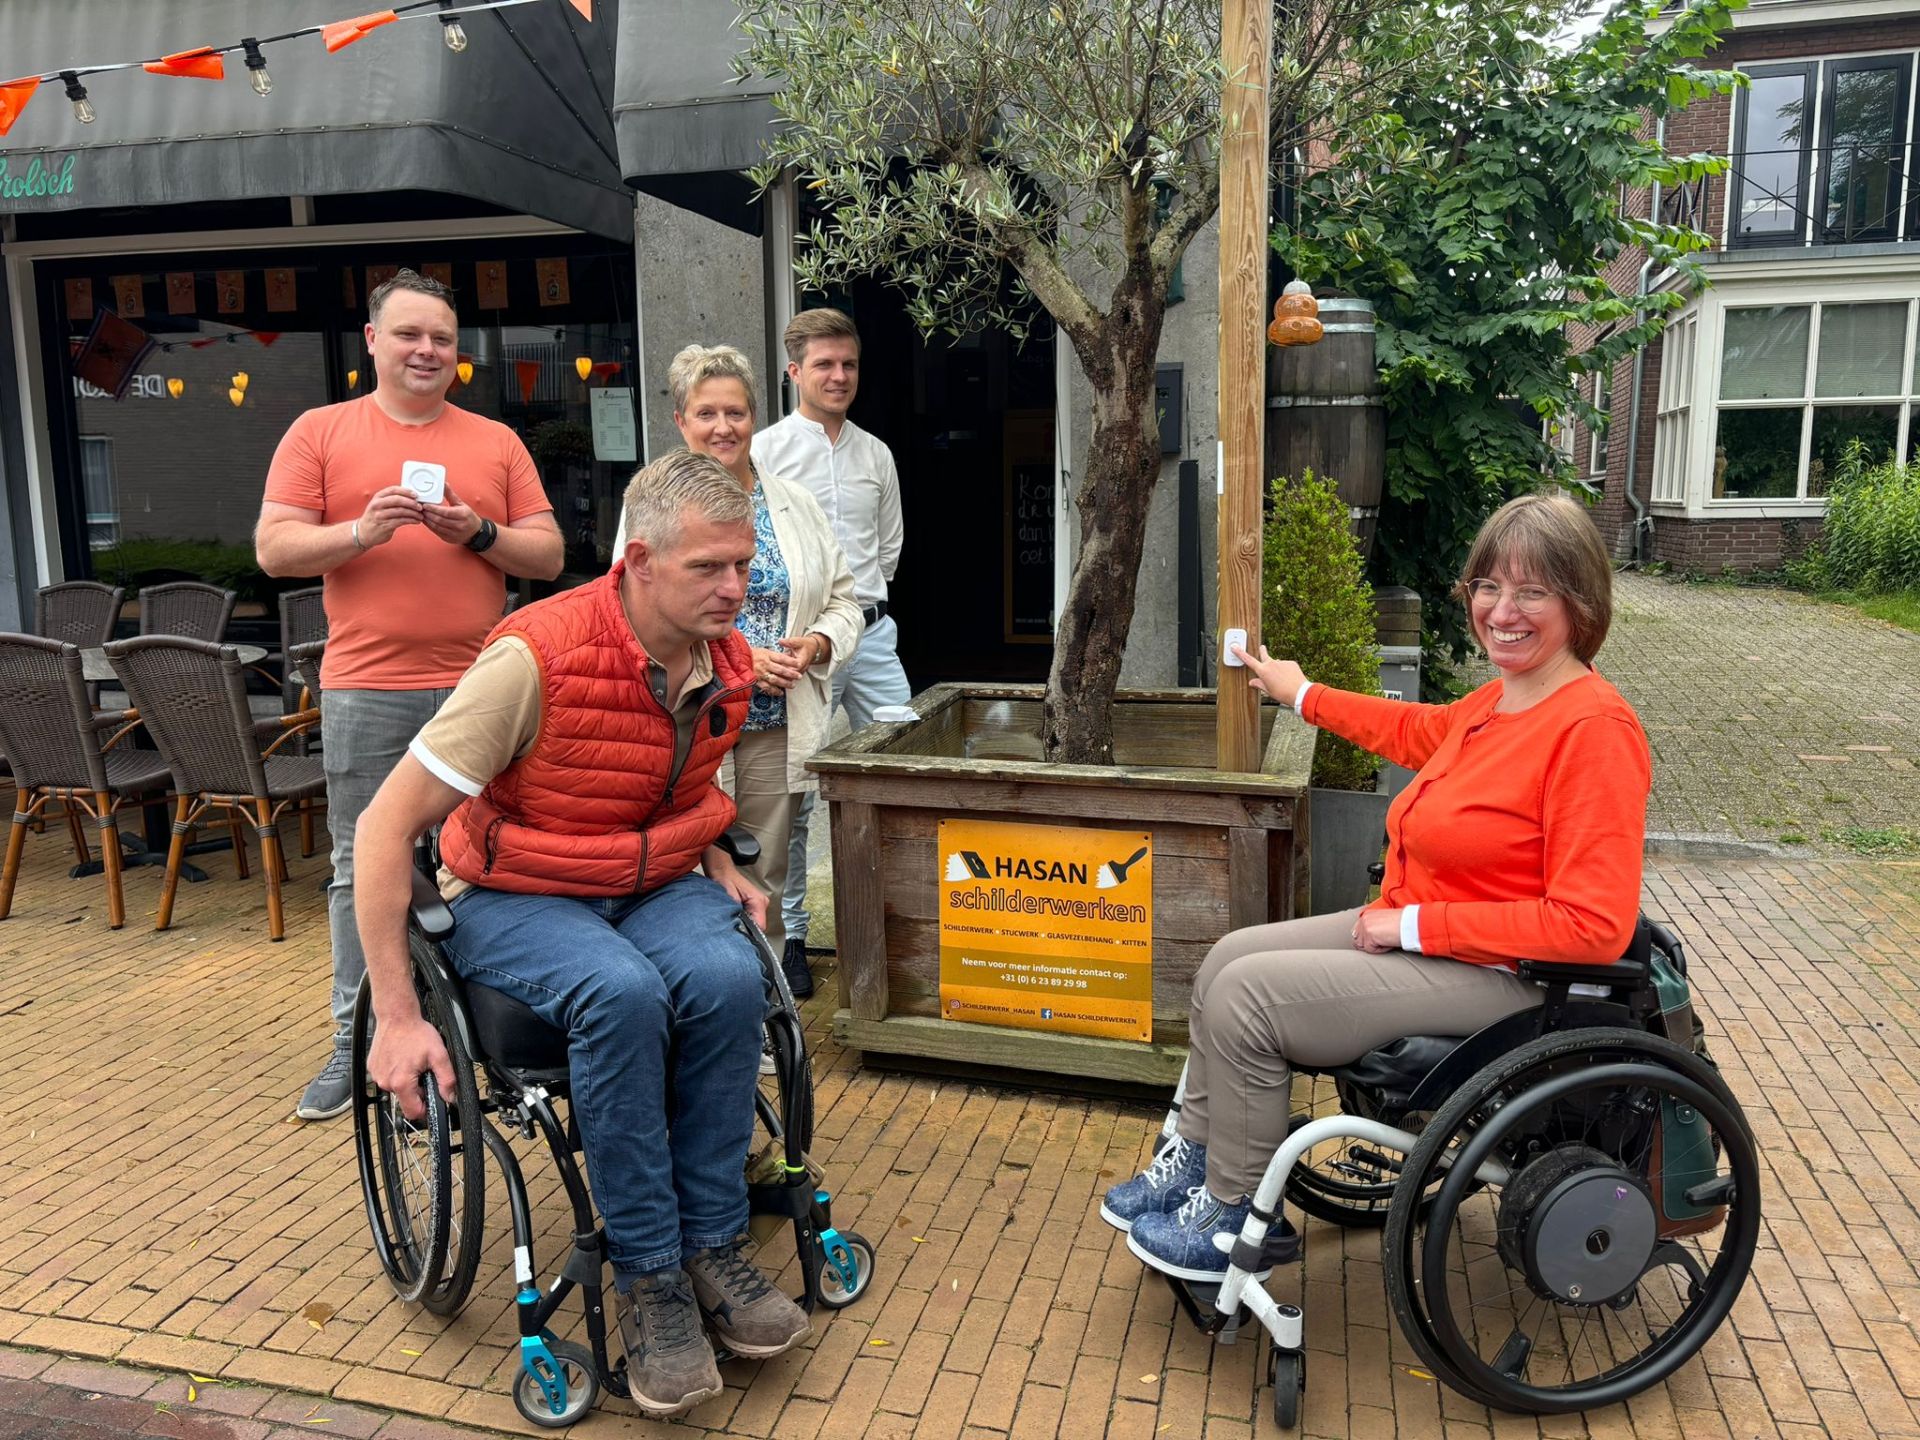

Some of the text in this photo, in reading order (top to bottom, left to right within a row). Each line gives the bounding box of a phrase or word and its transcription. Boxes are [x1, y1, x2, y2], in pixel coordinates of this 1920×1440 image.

[995, 855, 1087, 885] HASAN
[950, 886, 1146, 923] schilderwerken
[943, 923, 1147, 947] SCHILDERWERK STUCWERK GLASVEZELBEHANG KITTEN
[961, 957, 1128, 981] Neem voor meer informatie contact op:
[1000, 973, 1088, 989] +31 (0) 6 23 89 29 98
[1077, 1014, 1138, 1025] SCHILDERWERKEN
